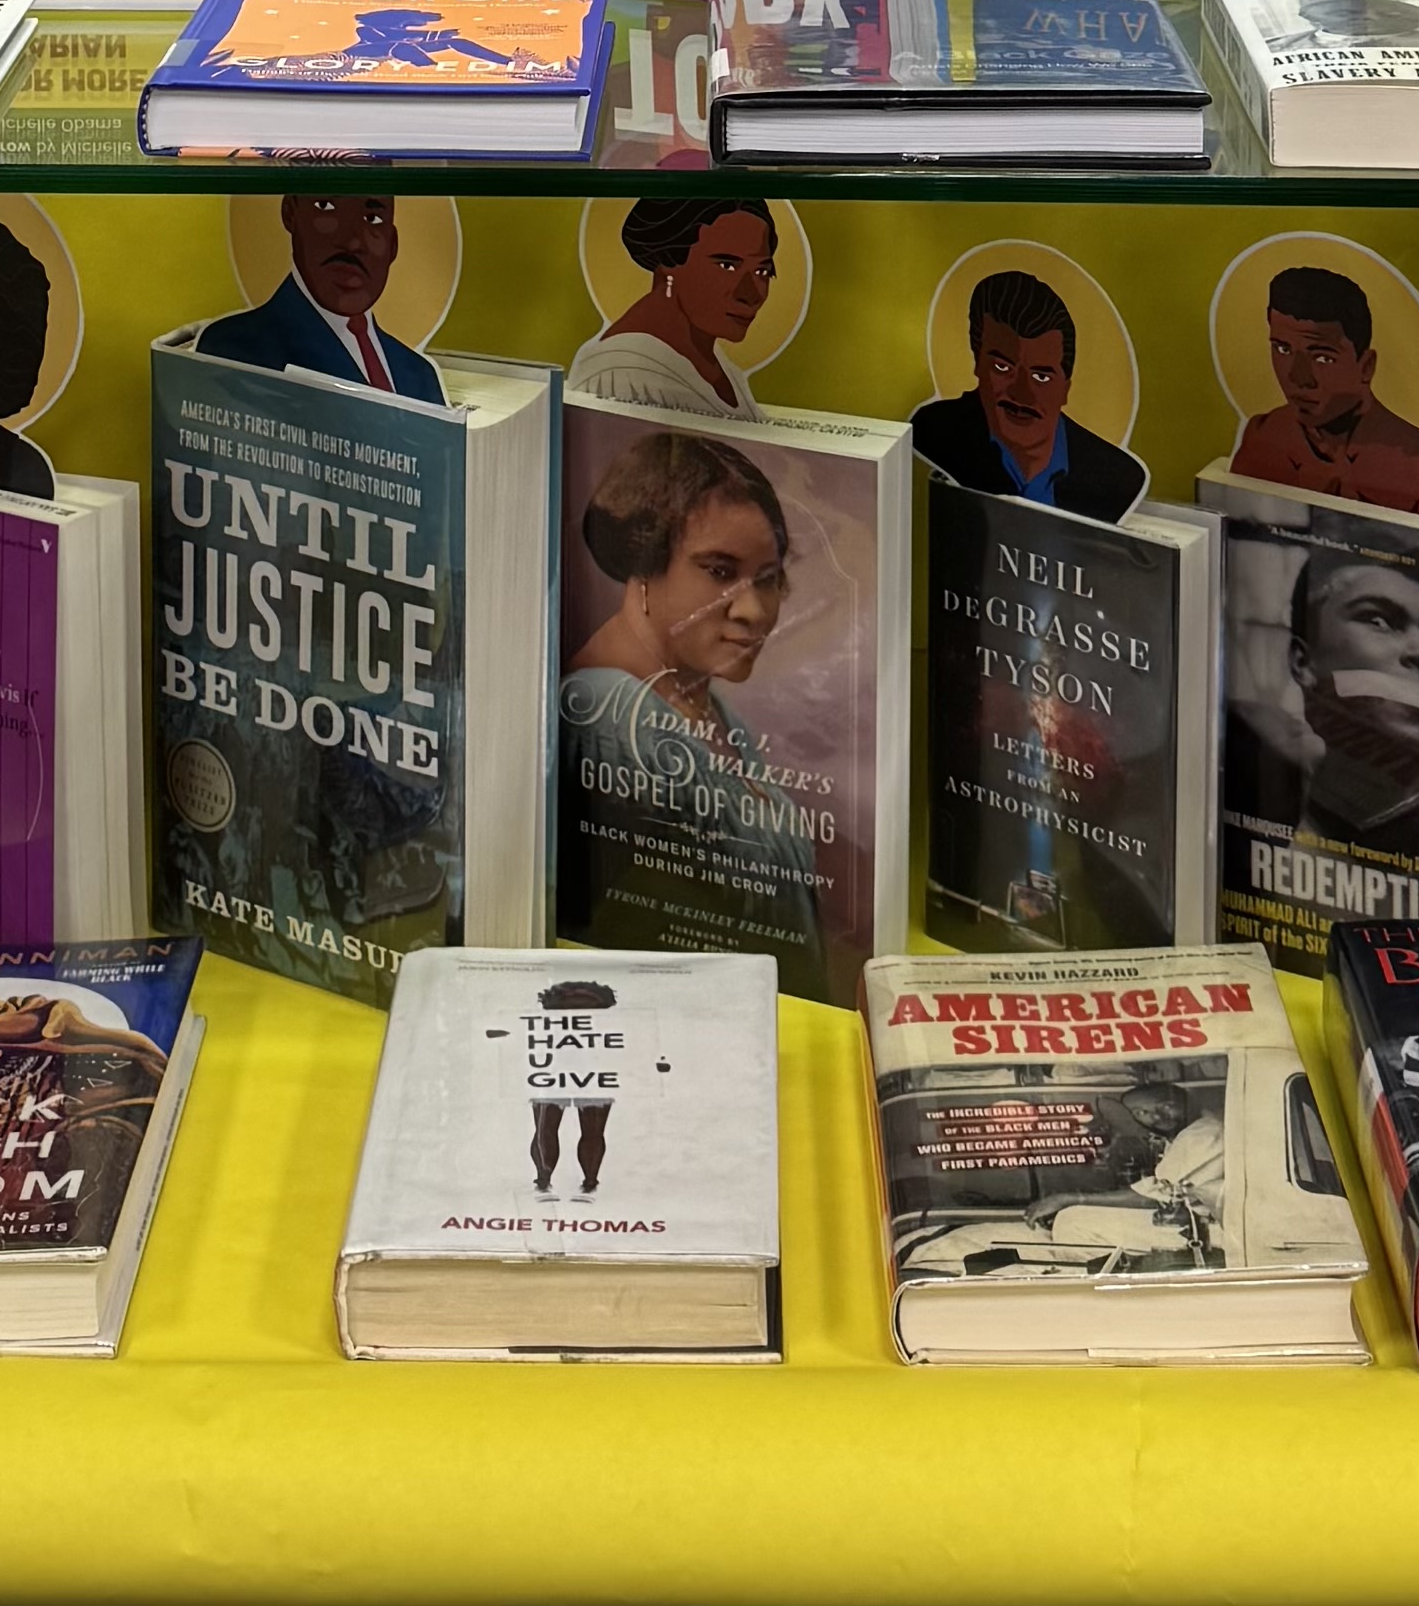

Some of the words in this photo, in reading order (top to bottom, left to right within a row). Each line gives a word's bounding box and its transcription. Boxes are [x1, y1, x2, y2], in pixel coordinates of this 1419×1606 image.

[165, 458, 436, 591] UNTIL
[999, 544, 1093, 598] NEIL
[165, 540, 436, 708] JUSTICE
[977, 647, 1112, 716] TYSON
[162, 649, 237, 716] BE
[254, 682, 439, 778] DONE
[520, 1016, 592, 1030] THE
[888, 984, 1253, 1026] AMERICAN
[528, 1033, 624, 1049] HATE
[953, 1019, 1207, 1054] SIRENS
[529, 1053, 552, 1068] U
[528, 1072, 619, 1088] GIVE
[441, 1217, 532, 1231] ANGIE
[542, 1219, 666, 1233] THOMAS
